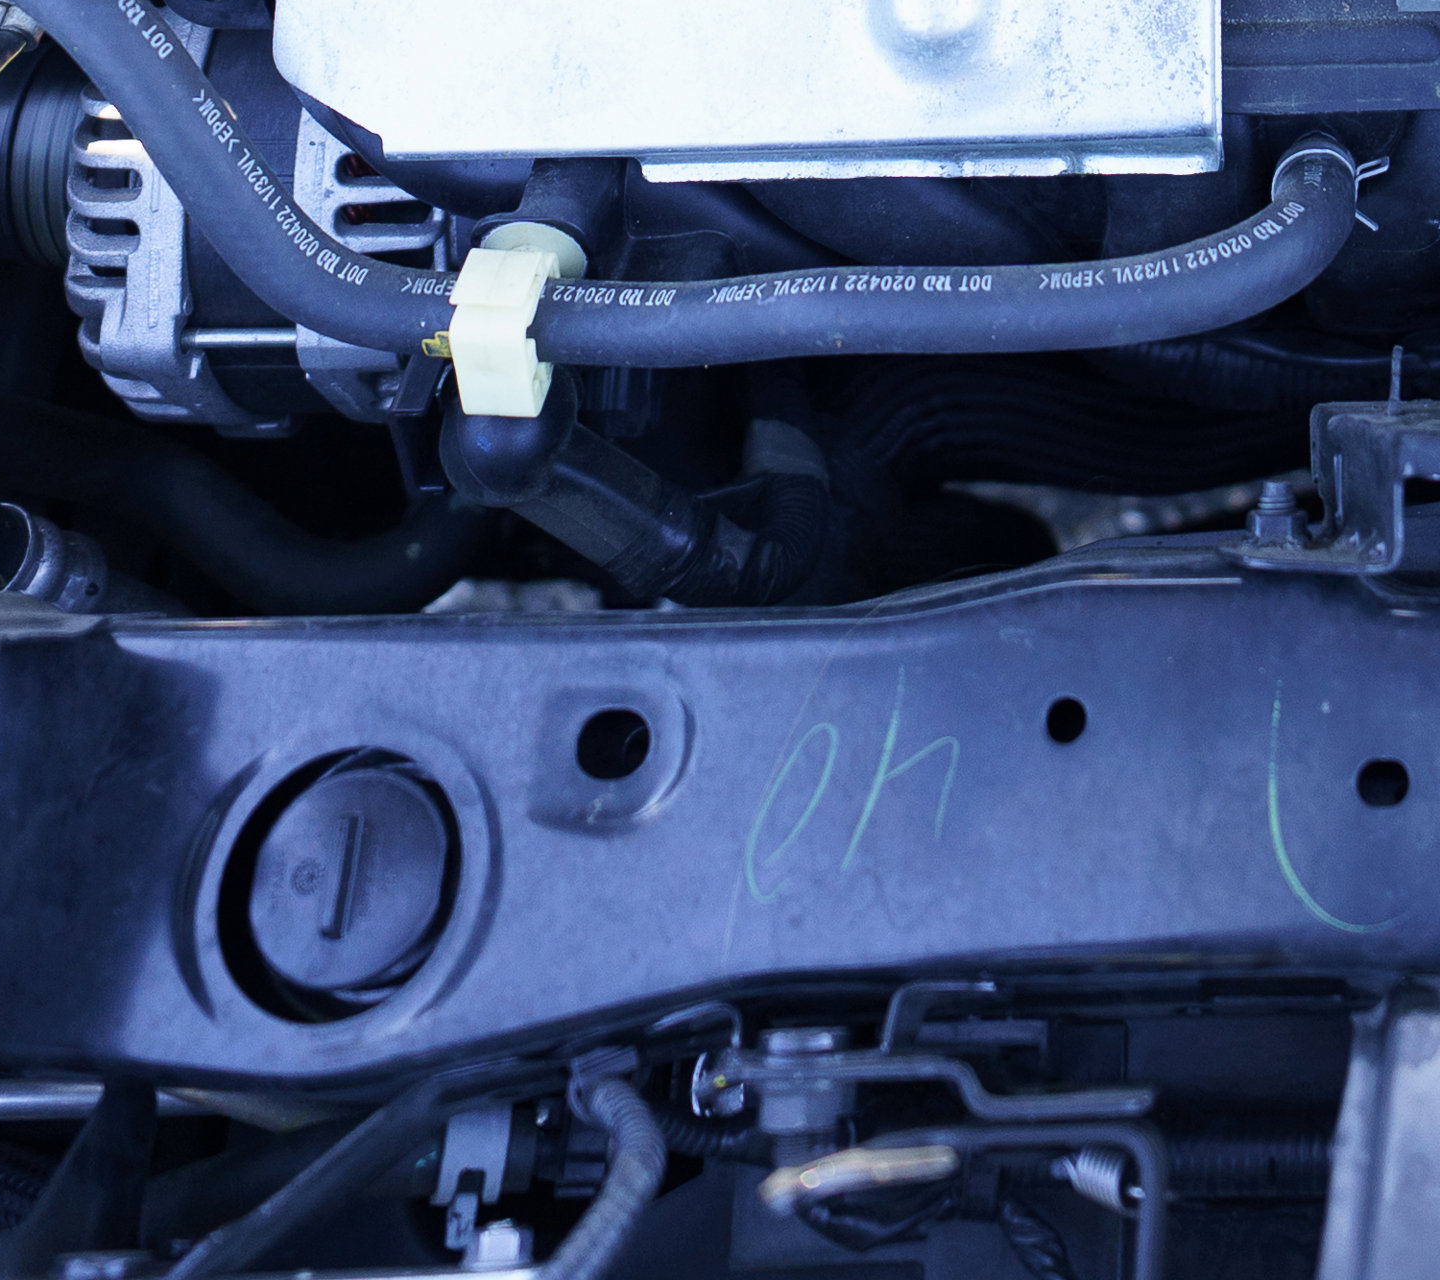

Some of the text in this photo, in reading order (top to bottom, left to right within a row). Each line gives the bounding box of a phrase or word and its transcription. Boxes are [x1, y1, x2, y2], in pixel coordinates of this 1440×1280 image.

[140, 24, 175, 61] DOT
[1277, 199, 1305, 227] DOT
[276, 205, 319, 257] 020422
[1187, 235, 1254, 271] 020422
[336, 261, 369, 286] DOT
[844, 273, 916, 293] 020422
[958, 272, 993, 292] DOT
[1039, 270, 1106, 290] >EPDM<
[552, 284, 616, 304] 020422
[644, 287, 677, 307] DOT
